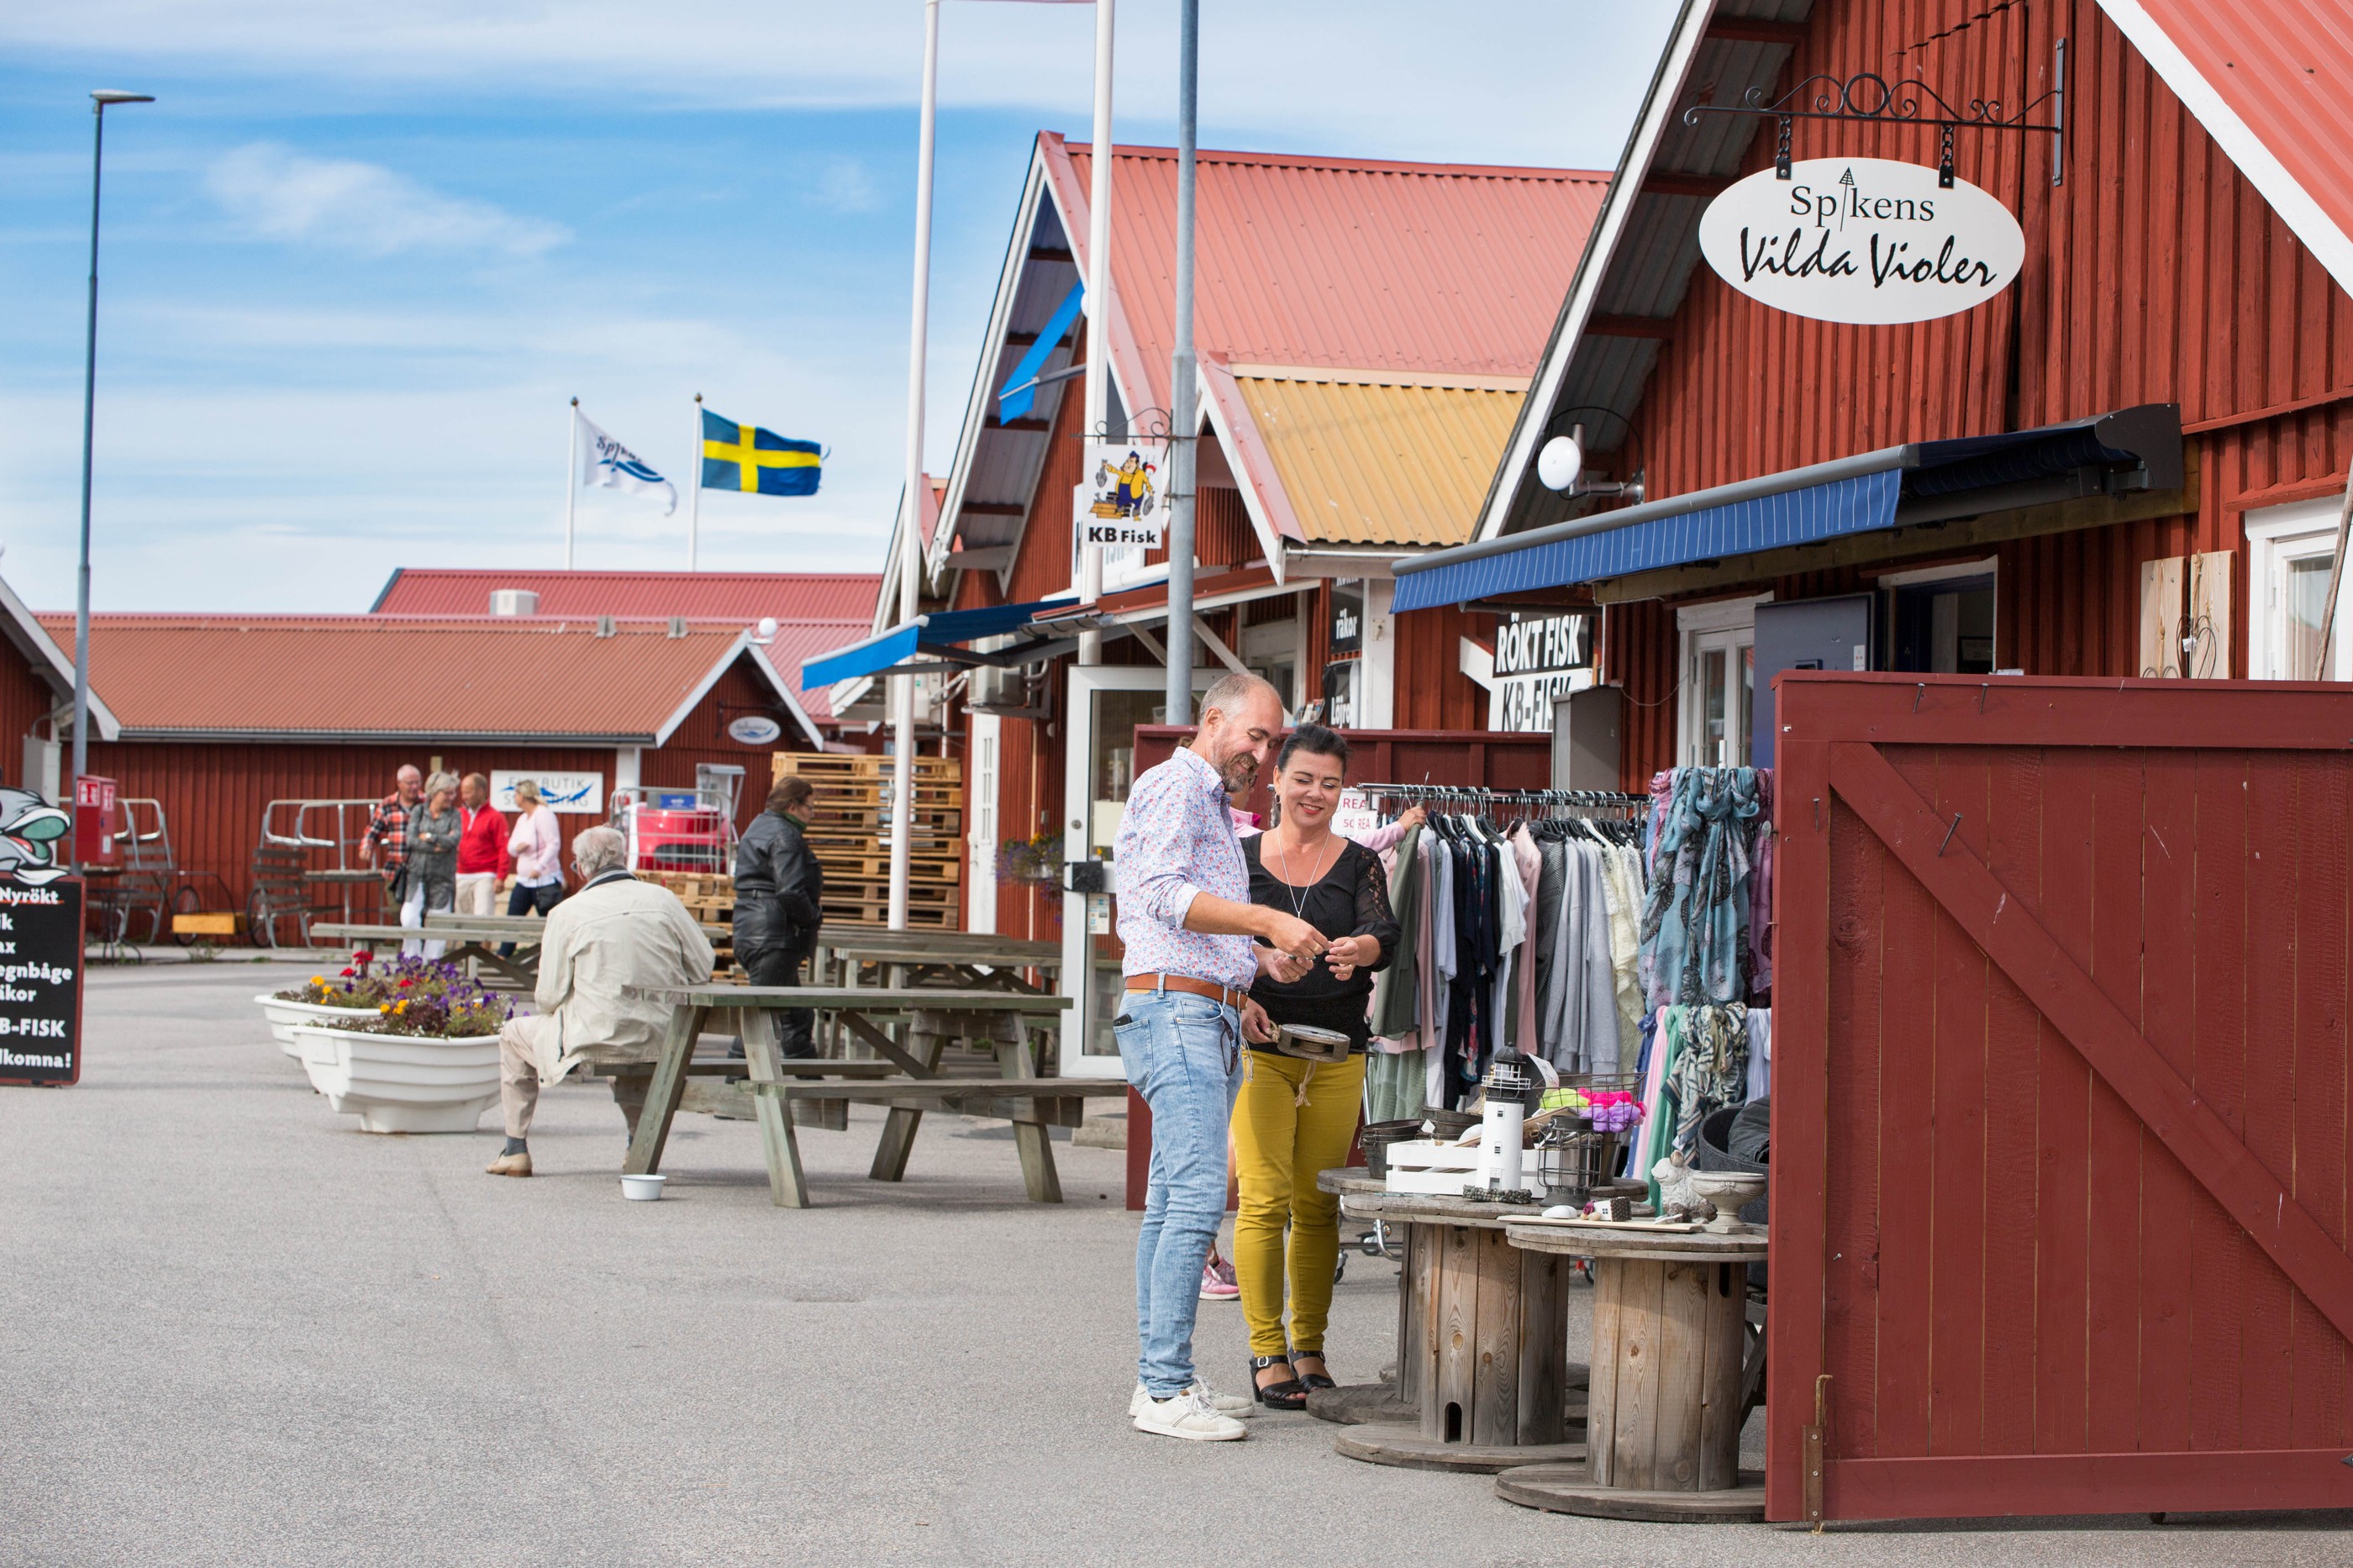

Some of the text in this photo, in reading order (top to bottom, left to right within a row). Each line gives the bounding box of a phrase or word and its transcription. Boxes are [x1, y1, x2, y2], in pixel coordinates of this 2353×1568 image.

[1740, 227, 1998, 288] Vilda Violer
[1088, 527, 1156, 544] KB Fisk
[1335, 608, 1358, 639] räkor
[1496, 613, 1582, 673] RÖKT FISK
[1357, 818, 1371, 830] REA
